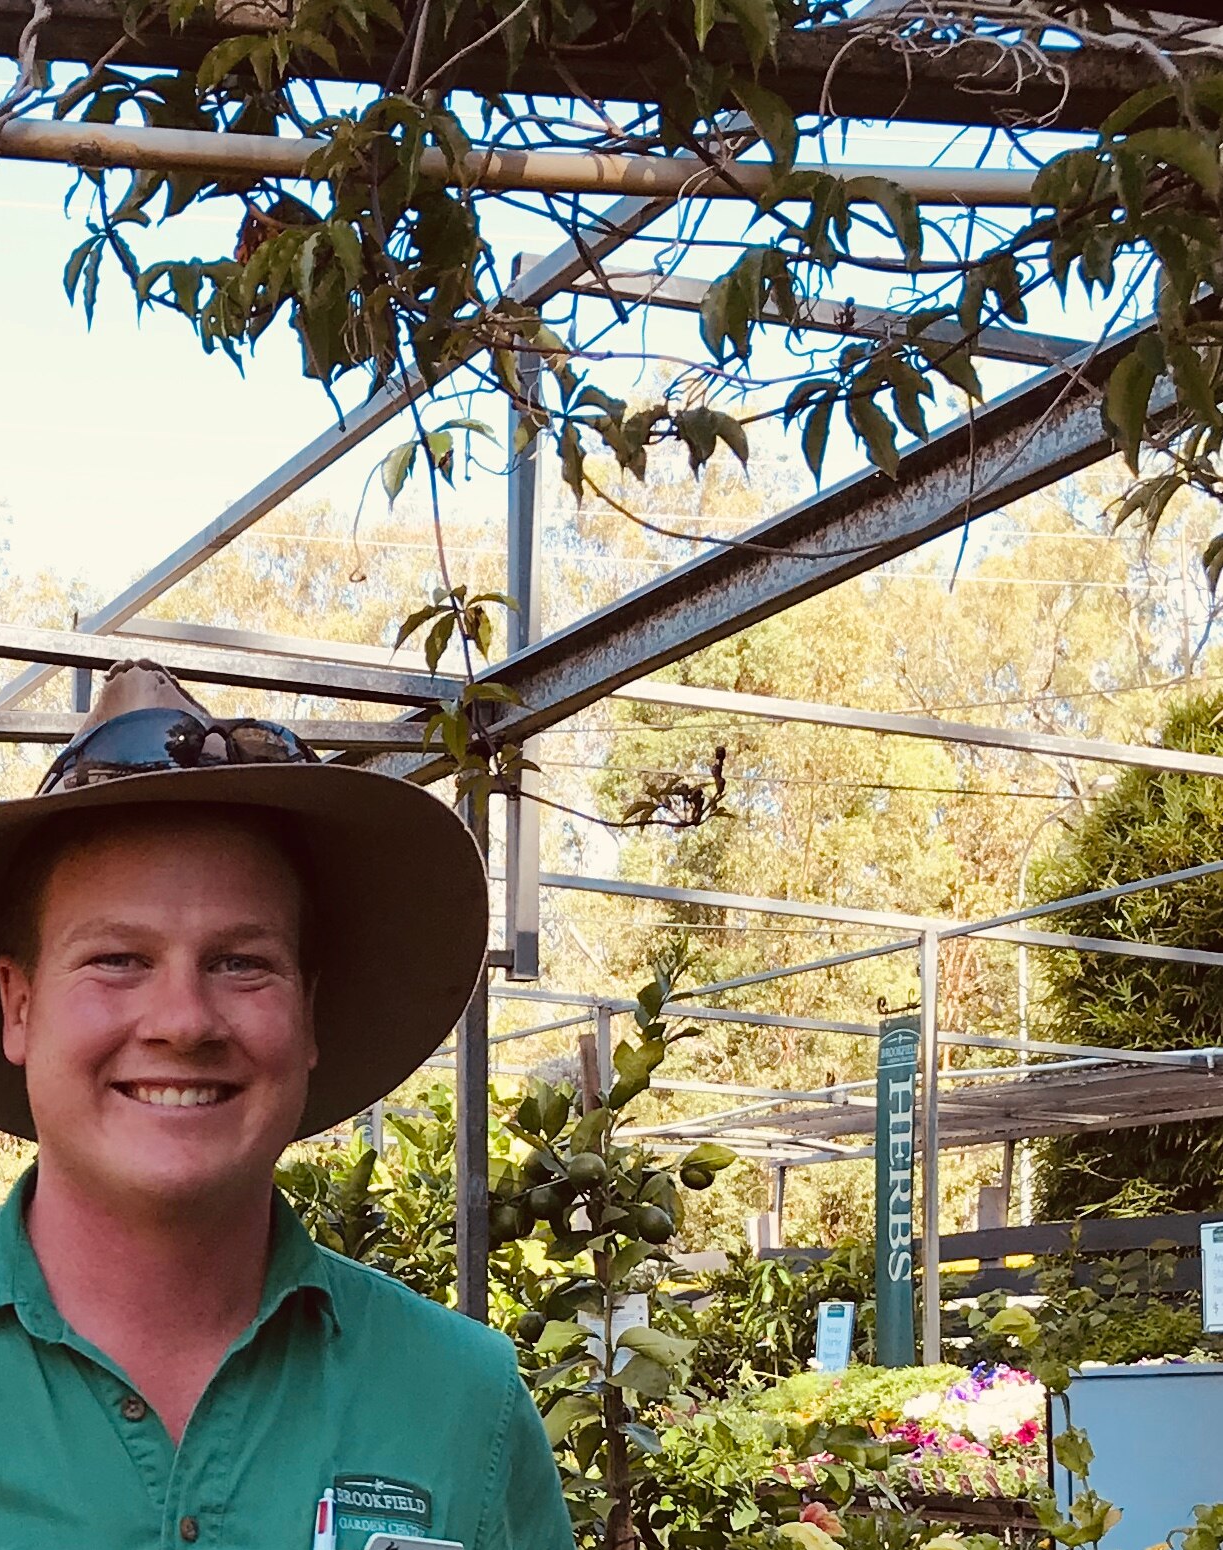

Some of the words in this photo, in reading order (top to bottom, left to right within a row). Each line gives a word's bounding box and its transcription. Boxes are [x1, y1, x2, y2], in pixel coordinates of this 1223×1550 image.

[888, 1074, 913, 1281] HERBS
[336, 1488, 427, 1513] BROOKFIELD
[339, 1517, 387, 1531] GARDEN
